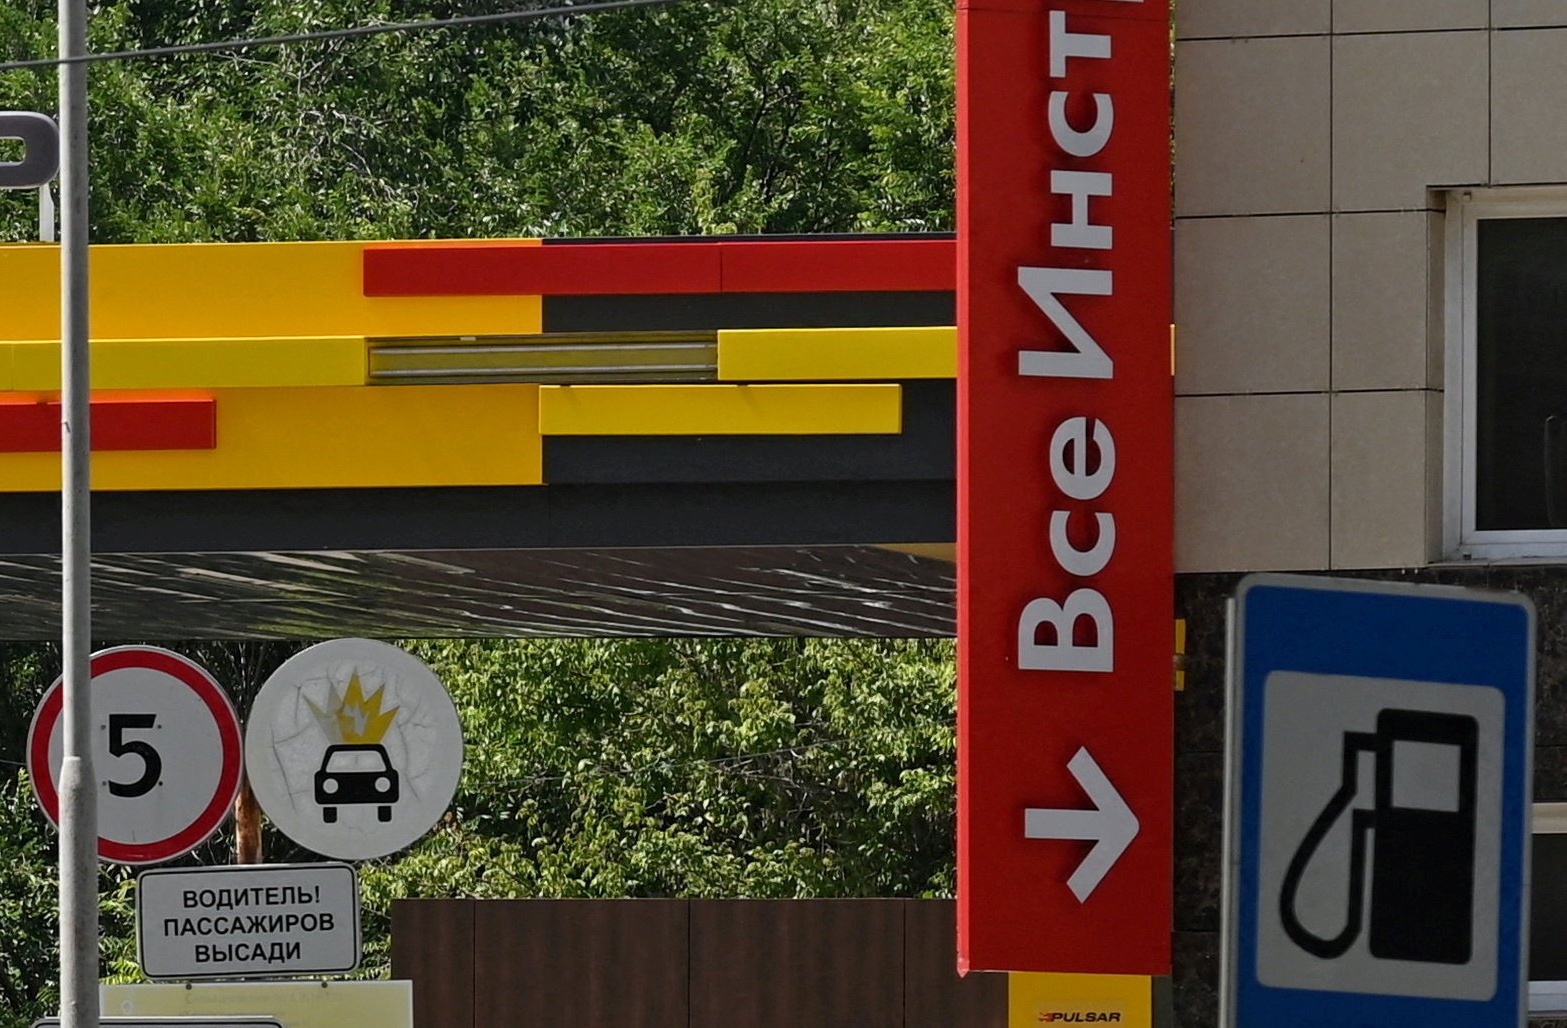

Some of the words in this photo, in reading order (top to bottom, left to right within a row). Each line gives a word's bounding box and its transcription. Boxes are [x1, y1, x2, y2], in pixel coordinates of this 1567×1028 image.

[1018, 0, 1128, 380] Инст
[1018, 416, 1116, 673] Все
[108, 714, 162, 798] 5
[183, 886, 320, 911] ВОДИТЕЛЬ!
[164, 913, 335, 936] ПАССАЖИРОВ
[195, 942, 301, 963] ВЫСАДИ
[1046, 1012, 1121, 1022] PULSAR
